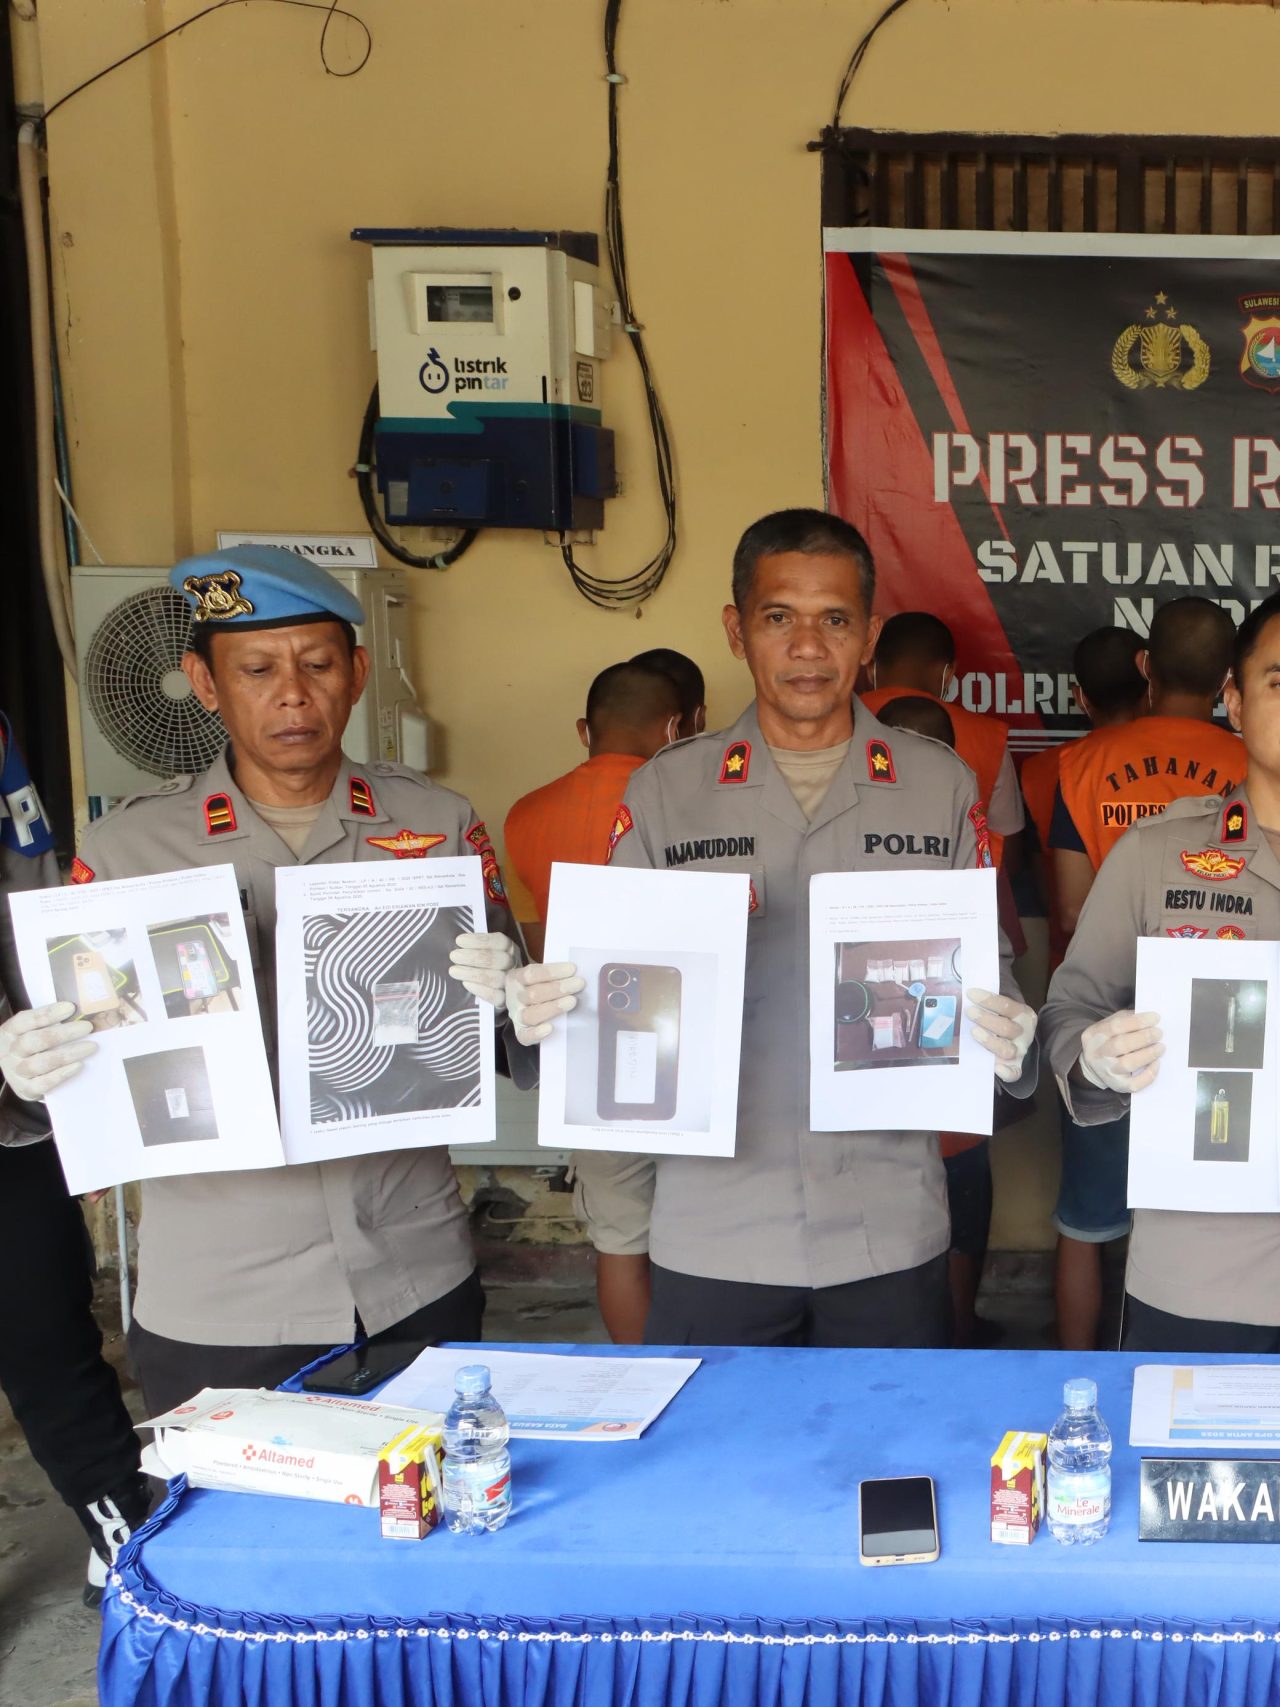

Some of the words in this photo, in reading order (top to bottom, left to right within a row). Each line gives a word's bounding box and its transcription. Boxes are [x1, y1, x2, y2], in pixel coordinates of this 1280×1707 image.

[1244, 297, 1279, 308] SULAWESI
[454, 357, 507, 374] listrik
[455, 375, 509, 393] pintar
[933, 432, 1205, 508] PRESS
[977, 540, 1234, 587] SATUAN
[1106, 756, 1235, 797] TAHANAN
[665, 837, 755, 867] NAJAMUDDIN
[864, 834, 950, 857] POLRI
[1165, 889, 1206, 909] RESTU
[1210, 892, 1253, 915] INDRA
[322, 1397, 381, 1412] Altamed
[257, 1448, 315, 1469] Altamed
[1057, 1503, 1100, 1517] Minerale
[1076, 1498, 1089, 1508] Le
